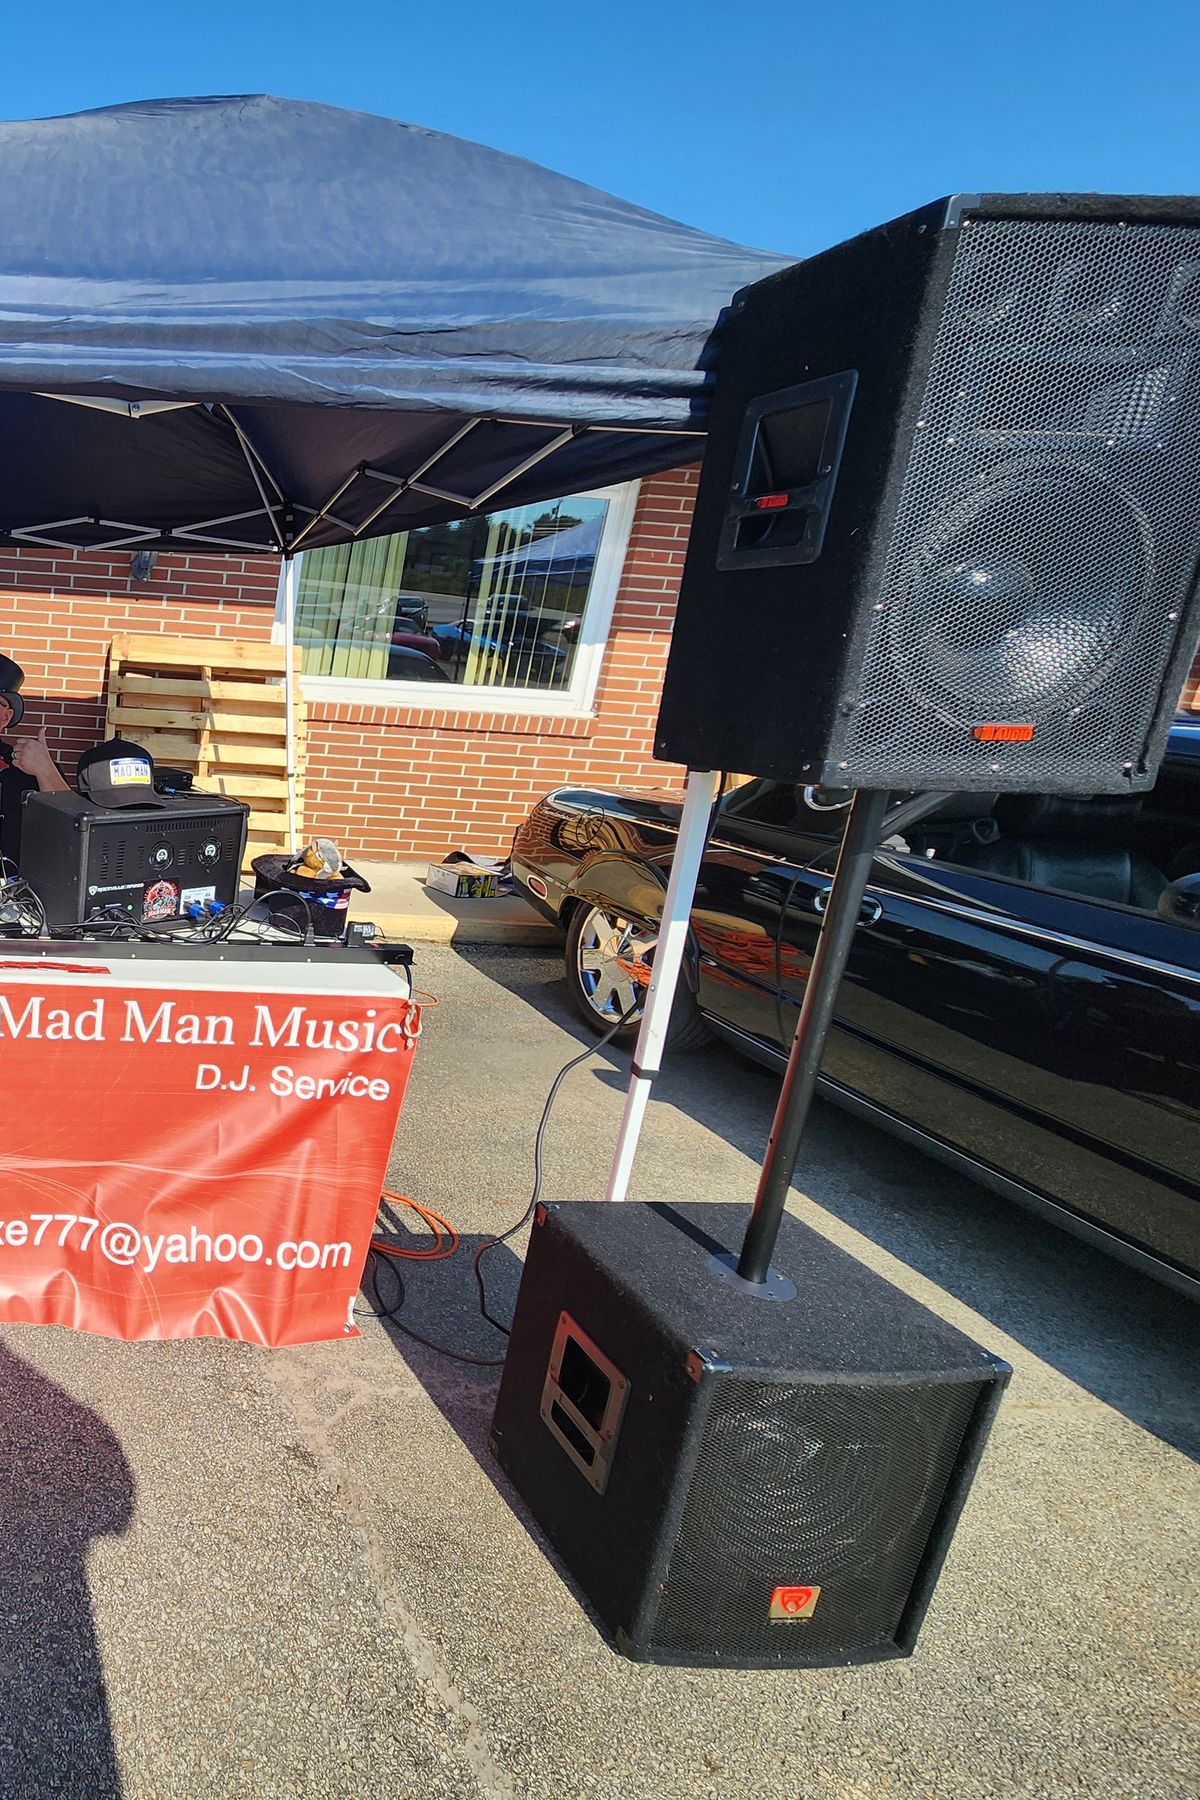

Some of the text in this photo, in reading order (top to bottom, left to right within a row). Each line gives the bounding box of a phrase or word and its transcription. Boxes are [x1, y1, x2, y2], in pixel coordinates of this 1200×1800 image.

[120, 1000, 235, 1047] Man
[249, 1005, 403, 1053] Music
[195, 1063, 391, 1101] D.J. Service
